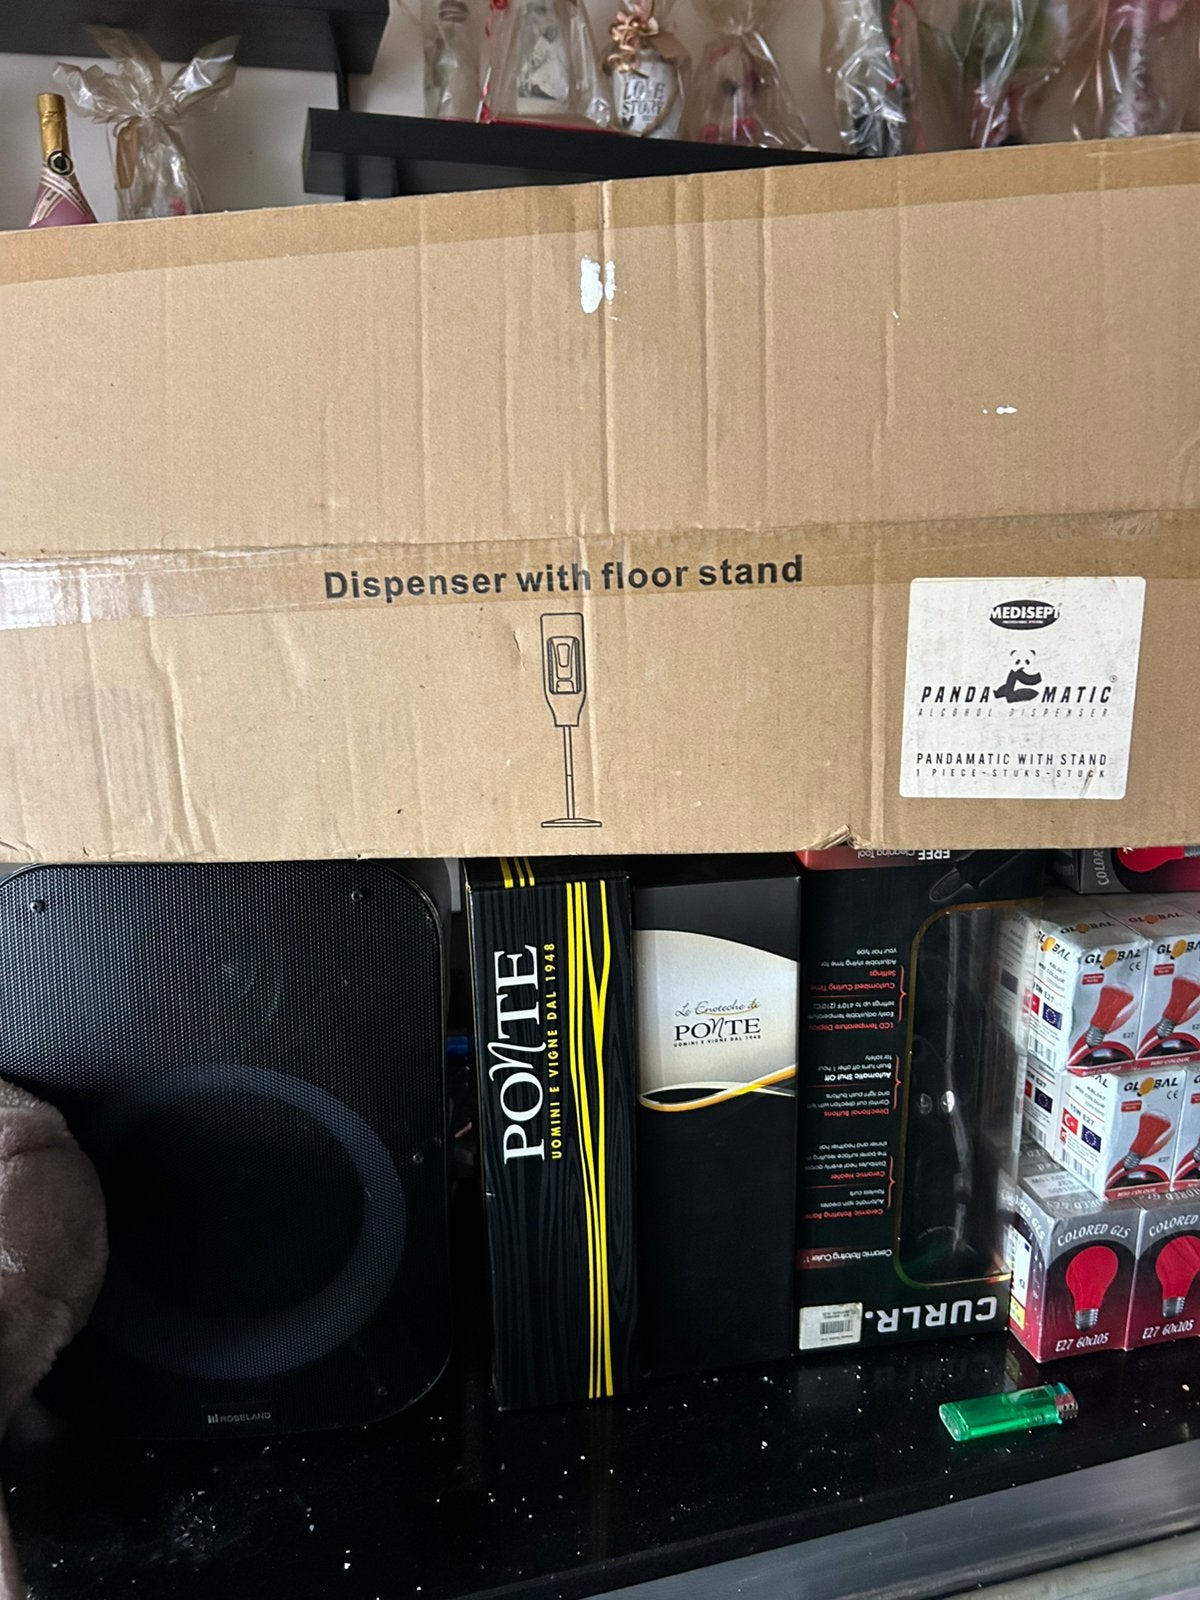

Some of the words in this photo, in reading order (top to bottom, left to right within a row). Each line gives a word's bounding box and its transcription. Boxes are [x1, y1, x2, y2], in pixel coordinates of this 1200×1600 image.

[324, 569, 507, 603] Dispenser
[516, 562, 592, 593] with
[602, 561, 689, 590] floor
[699, 554, 804, 587] stand
[989, 606, 1061, 619] MEDISEPT
[921, 686, 990, 704] PANDA
[1041, 686, 1112, 704] MATIC
[918, 708, 993, 717] ALCOHOL
[1009, 708, 1109, 717] DISPENSER
[916, 753, 1011, 765] PANDAMATIC
[1017, 753, 1054, 765] WITH
[1060, 753, 1107, 766] STAND
[915, 768, 920, 777] 1
[1093, 850, 1110, 886] COLOR
[856, 948, 870, 956] type
[883, 947, 897, 955] your
[544, 943, 556, 982] 1948
[830, 960, 844, 968] time
[845, 959, 864, 967] styling
[869, 969, 896, 978] Settings
[828, 983, 854, 992] Curling
[854, 982, 896, 990] Customized
[546, 991, 558, 1020] DAL
[807, 1012, 844, 1020] temperature
[846, 1011, 877, 1020] adjustable
[878, 1010, 894, 1018] Easily
[834, 1022, 878, 1030] Temperature
[547, 1029, 559, 1078] VIGNE
[876, 1062, 892, 1070] Brush
[824, 1074, 836, 1082] Off
[826, 1092, 848, 1100] buttons
[830, 1100, 856, 1108] direction
[850, 1108, 889, 1116] Directional
[550, 1102, 562, 1159] UOMINI
[830, 1172, 854, 1180] Heater
[856, 1170, 886, 1178] Ceramic
[855, 1198, 884, 1206] Automatic
[824, 1210, 852, 1218] Rotating
[1148, 1214, 1199, 1237] COLORED
[1057, 1223, 1109, 1247] COLORED
[1110, 1225, 1131, 1239] GLS
[832, 1252, 861, 1260] Rotating
[862, 1249, 892, 1257] Ceramic
[810, 1254, 832, 1262] Curler
[865, 1295, 998, 1334] CURLR.
[1142, 1326, 1160, 1339] E27
[1055, 1339, 1074, 1352] E27
